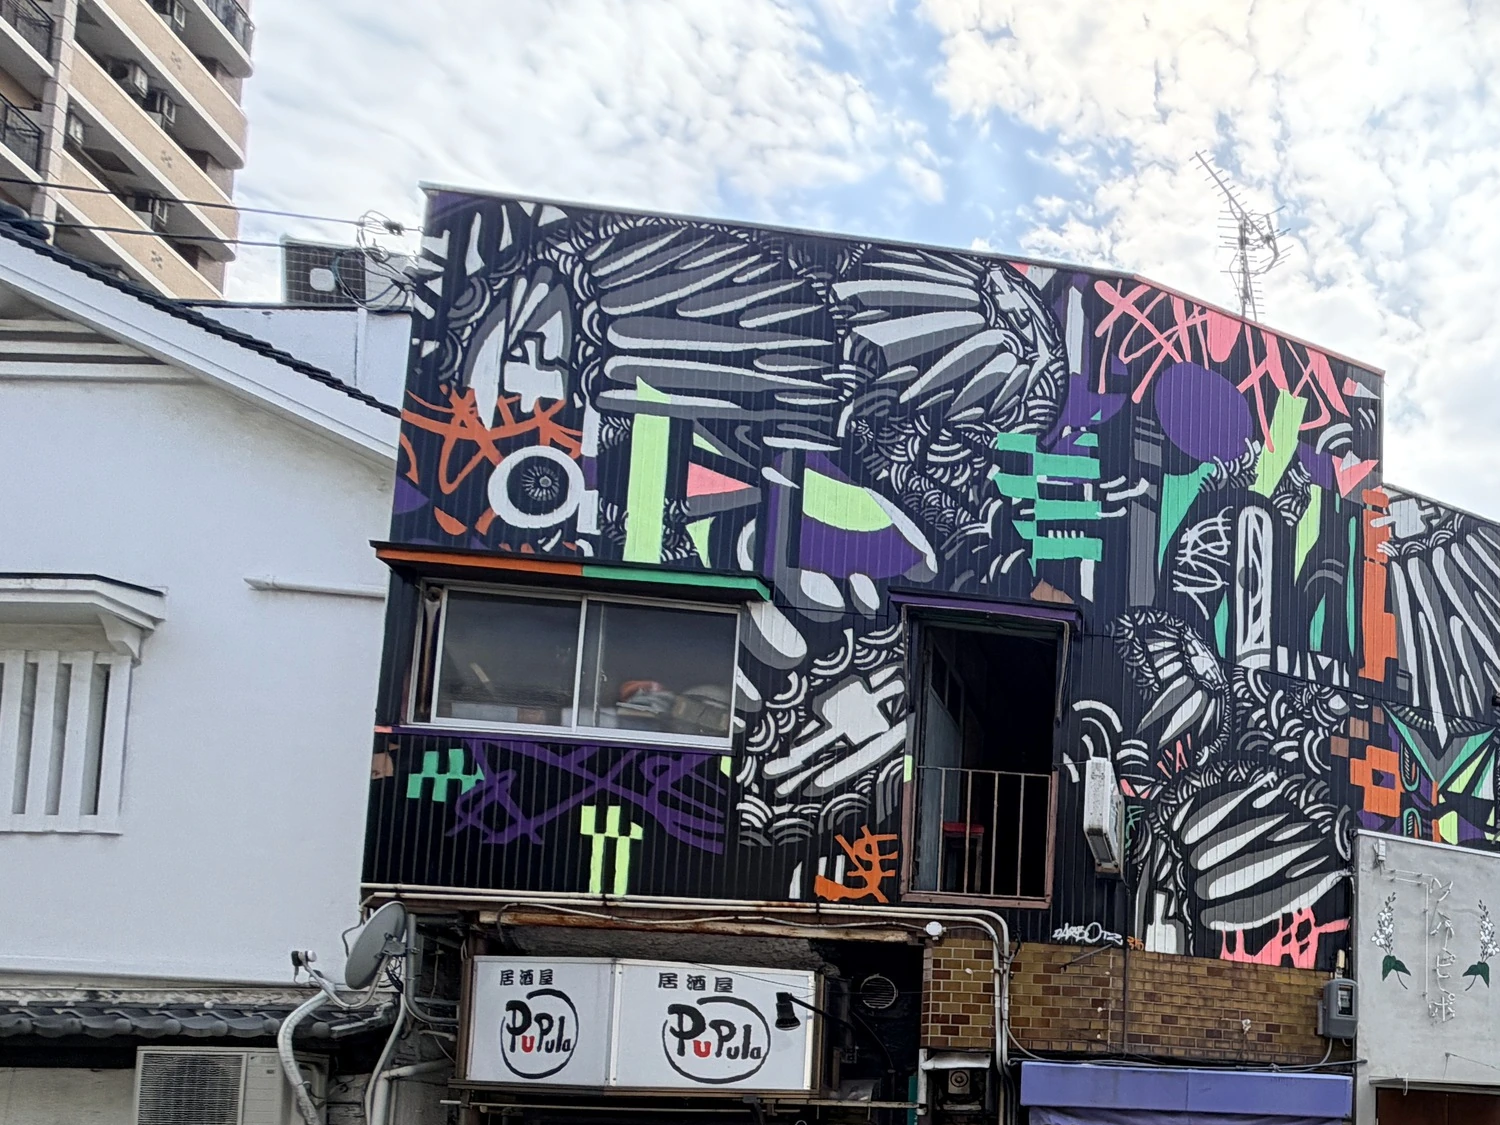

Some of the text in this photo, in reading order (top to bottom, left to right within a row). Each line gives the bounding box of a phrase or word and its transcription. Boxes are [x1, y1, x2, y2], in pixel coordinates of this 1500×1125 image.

[500, 968, 554, 986] 居酒屋
[658, 972, 734, 993] 居酒屋
